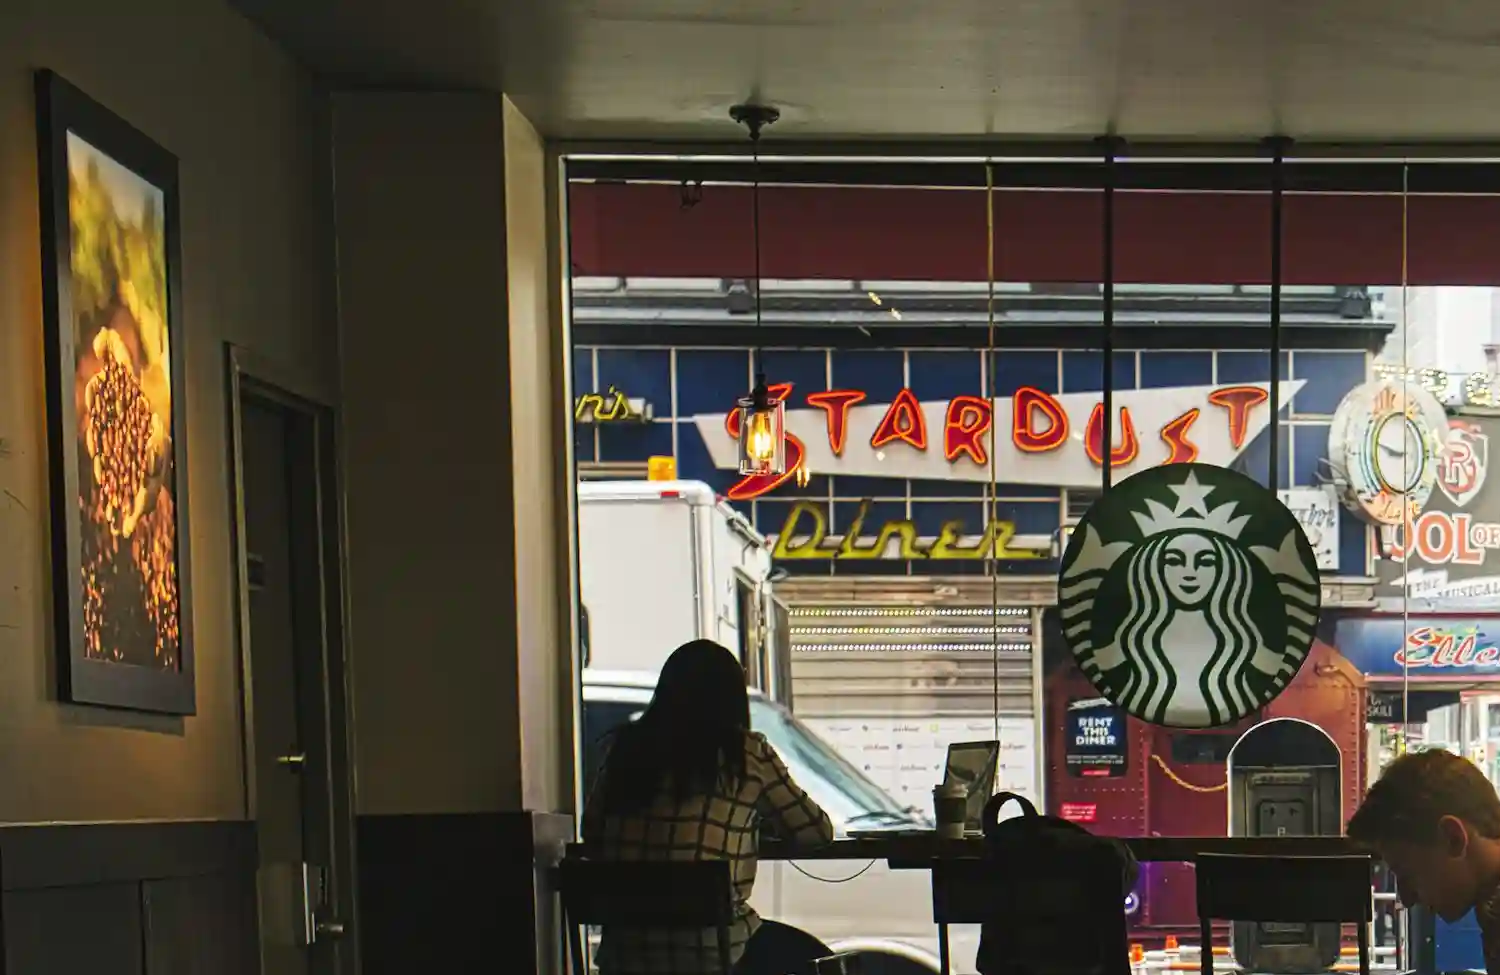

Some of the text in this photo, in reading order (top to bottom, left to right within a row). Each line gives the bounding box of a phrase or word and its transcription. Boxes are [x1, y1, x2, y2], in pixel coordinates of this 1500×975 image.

[725, 382, 1269, 500] STARDUST
[773, 498, 1050, 561] Diner
[1374, 510, 1486, 566] OOL
[1077, 716, 1113, 728] RENT
[1082, 727, 1109, 737] THIS
[1075, 735, 1116, 746] DINER
